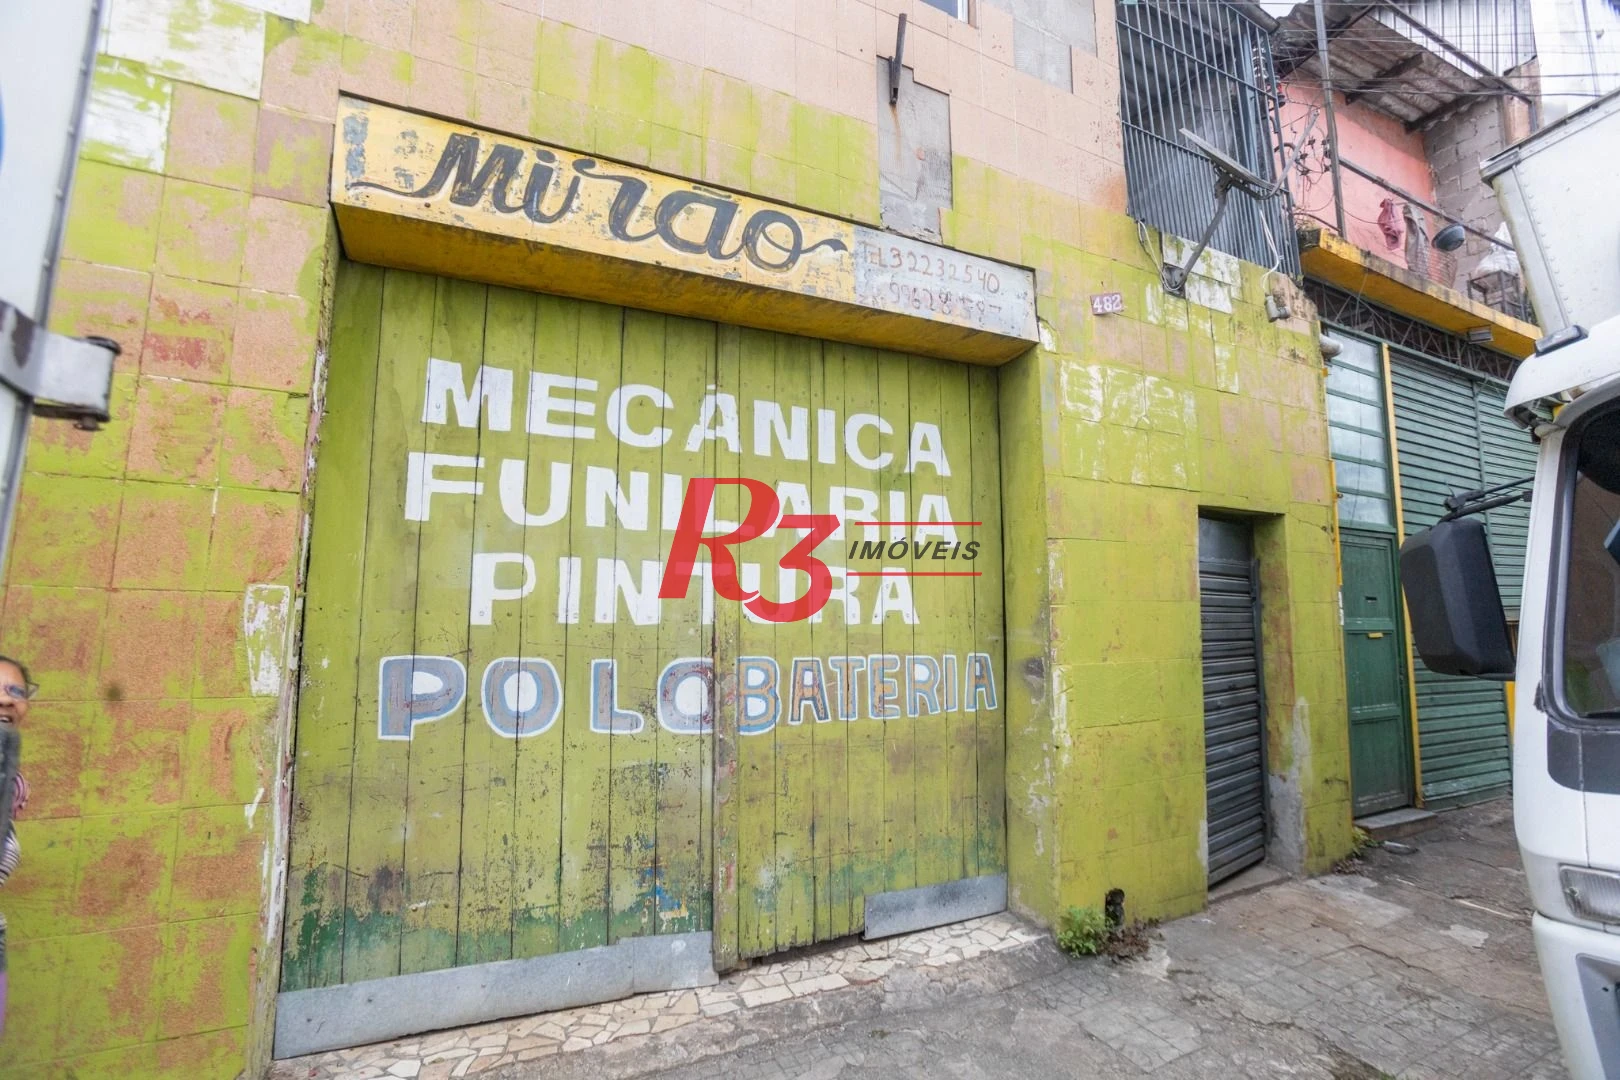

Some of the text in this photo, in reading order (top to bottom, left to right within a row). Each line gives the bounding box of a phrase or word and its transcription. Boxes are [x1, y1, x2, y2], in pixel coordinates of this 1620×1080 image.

[1092, 293, 1122, 313] 482
[421, 357, 952, 477] MECÂNICA
[470, 552, 920, 626] PINTURA
[738, 652, 999, 736] BATERIA
